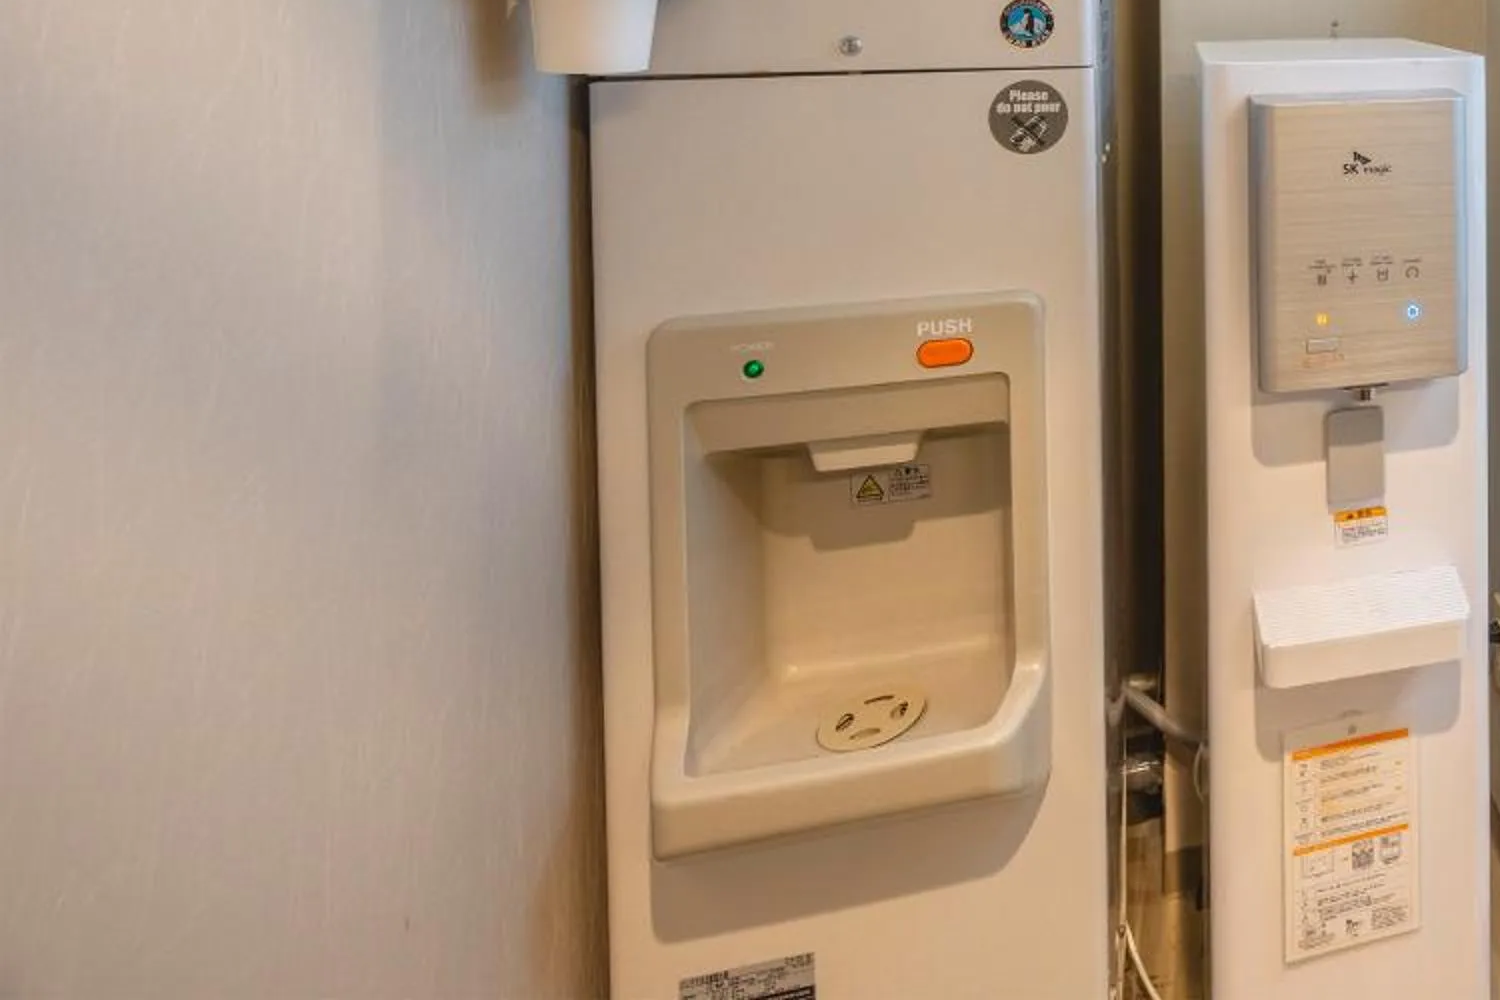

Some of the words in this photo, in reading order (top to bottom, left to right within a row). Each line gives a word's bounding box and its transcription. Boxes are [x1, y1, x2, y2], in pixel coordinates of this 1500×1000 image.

[1009, 89, 1049, 101] Please
[997, 103, 1011, 114] do
[1013, 102, 1033, 114] not
[1033, 102, 1061, 115] pour
[916, 318, 973, 337] PUSH
